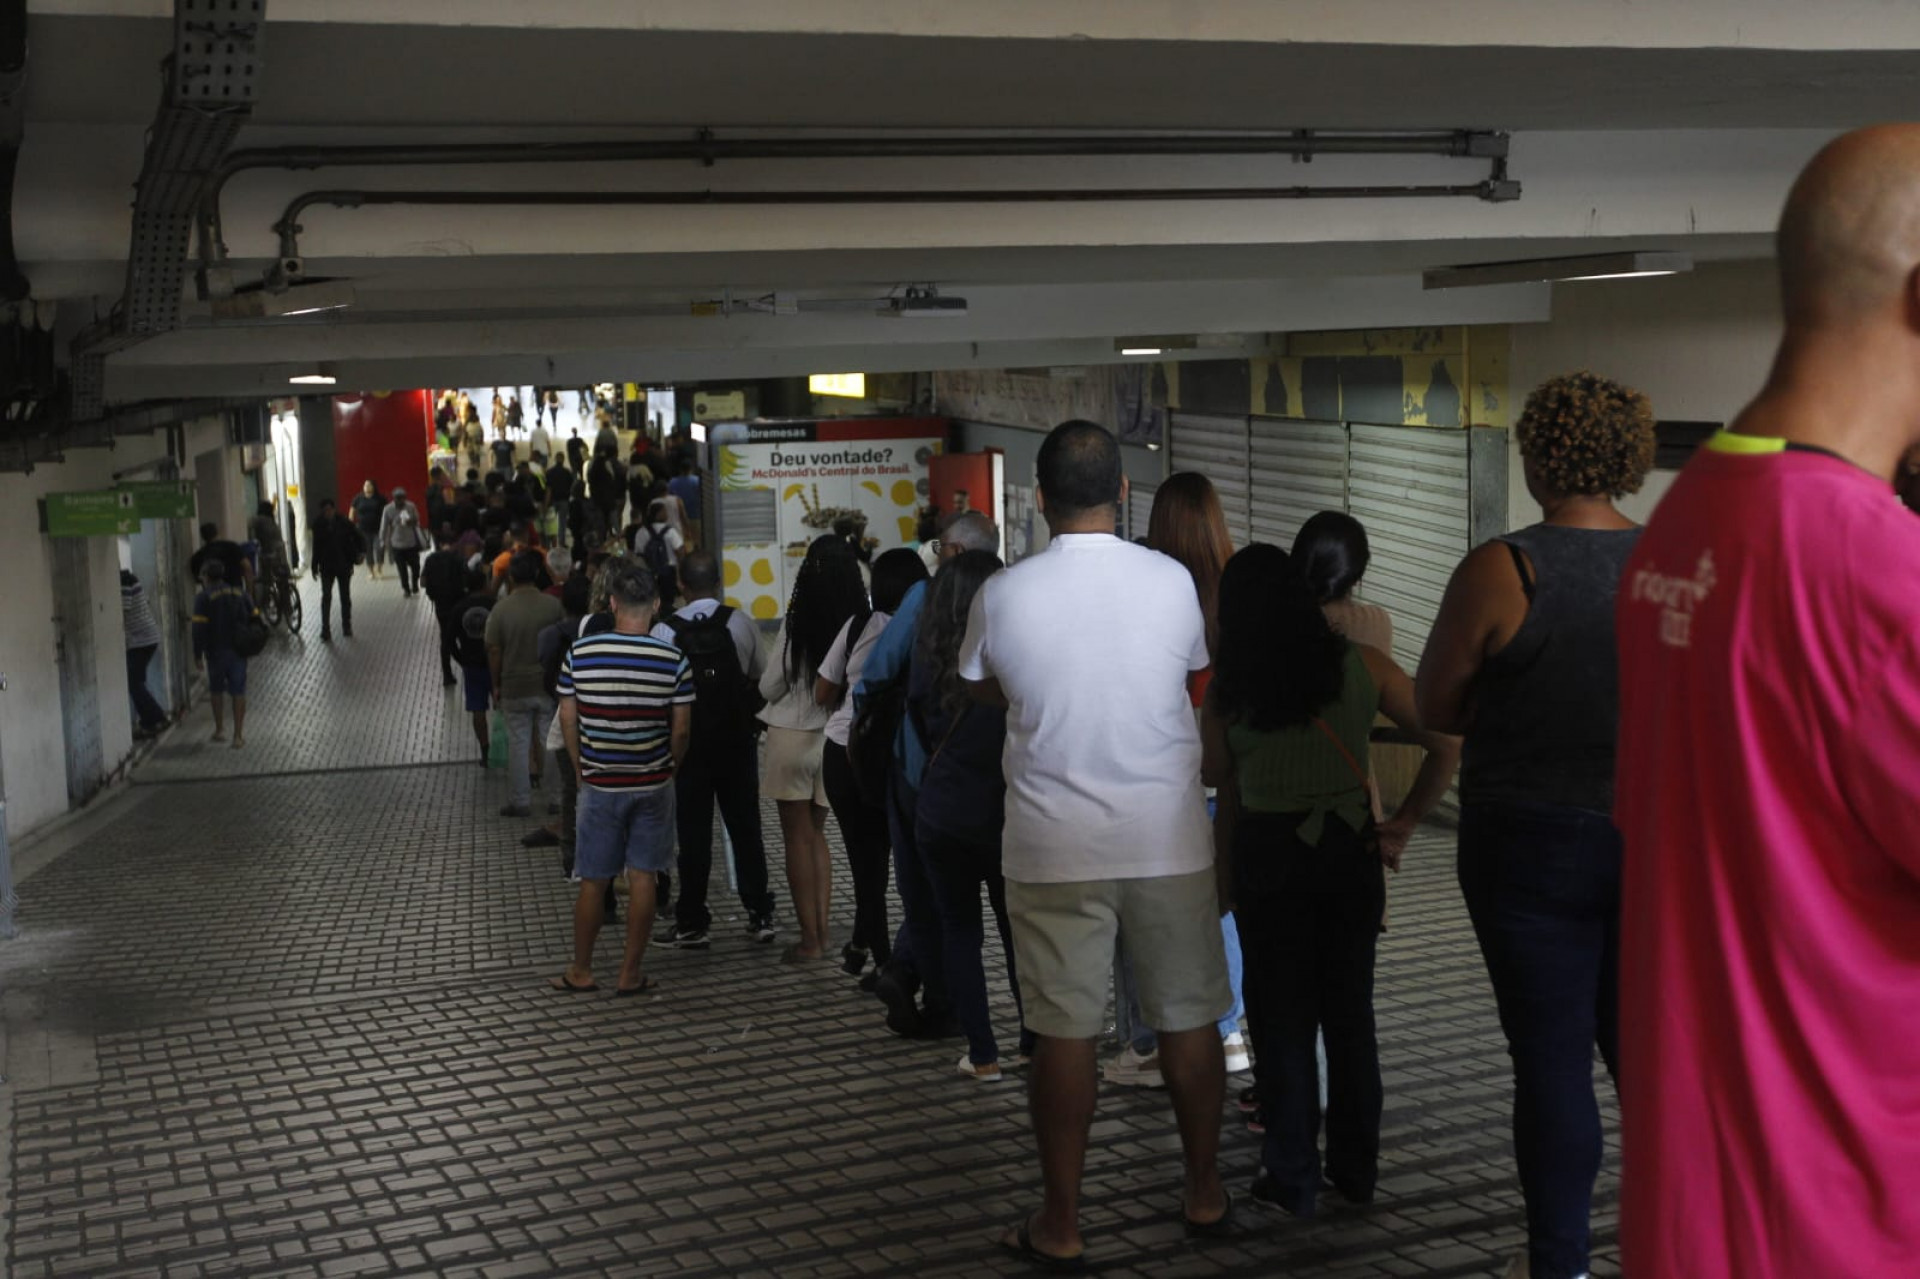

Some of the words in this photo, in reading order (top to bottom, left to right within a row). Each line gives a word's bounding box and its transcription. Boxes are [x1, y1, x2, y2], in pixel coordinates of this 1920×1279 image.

[771, 452, 805, 466] Deu
[810, 448, 893, 465] vontade?
[752, 467, 817, 479] McDonald's
[818, 466, 860, 477] Central
[862, 466, 875, 475] do
